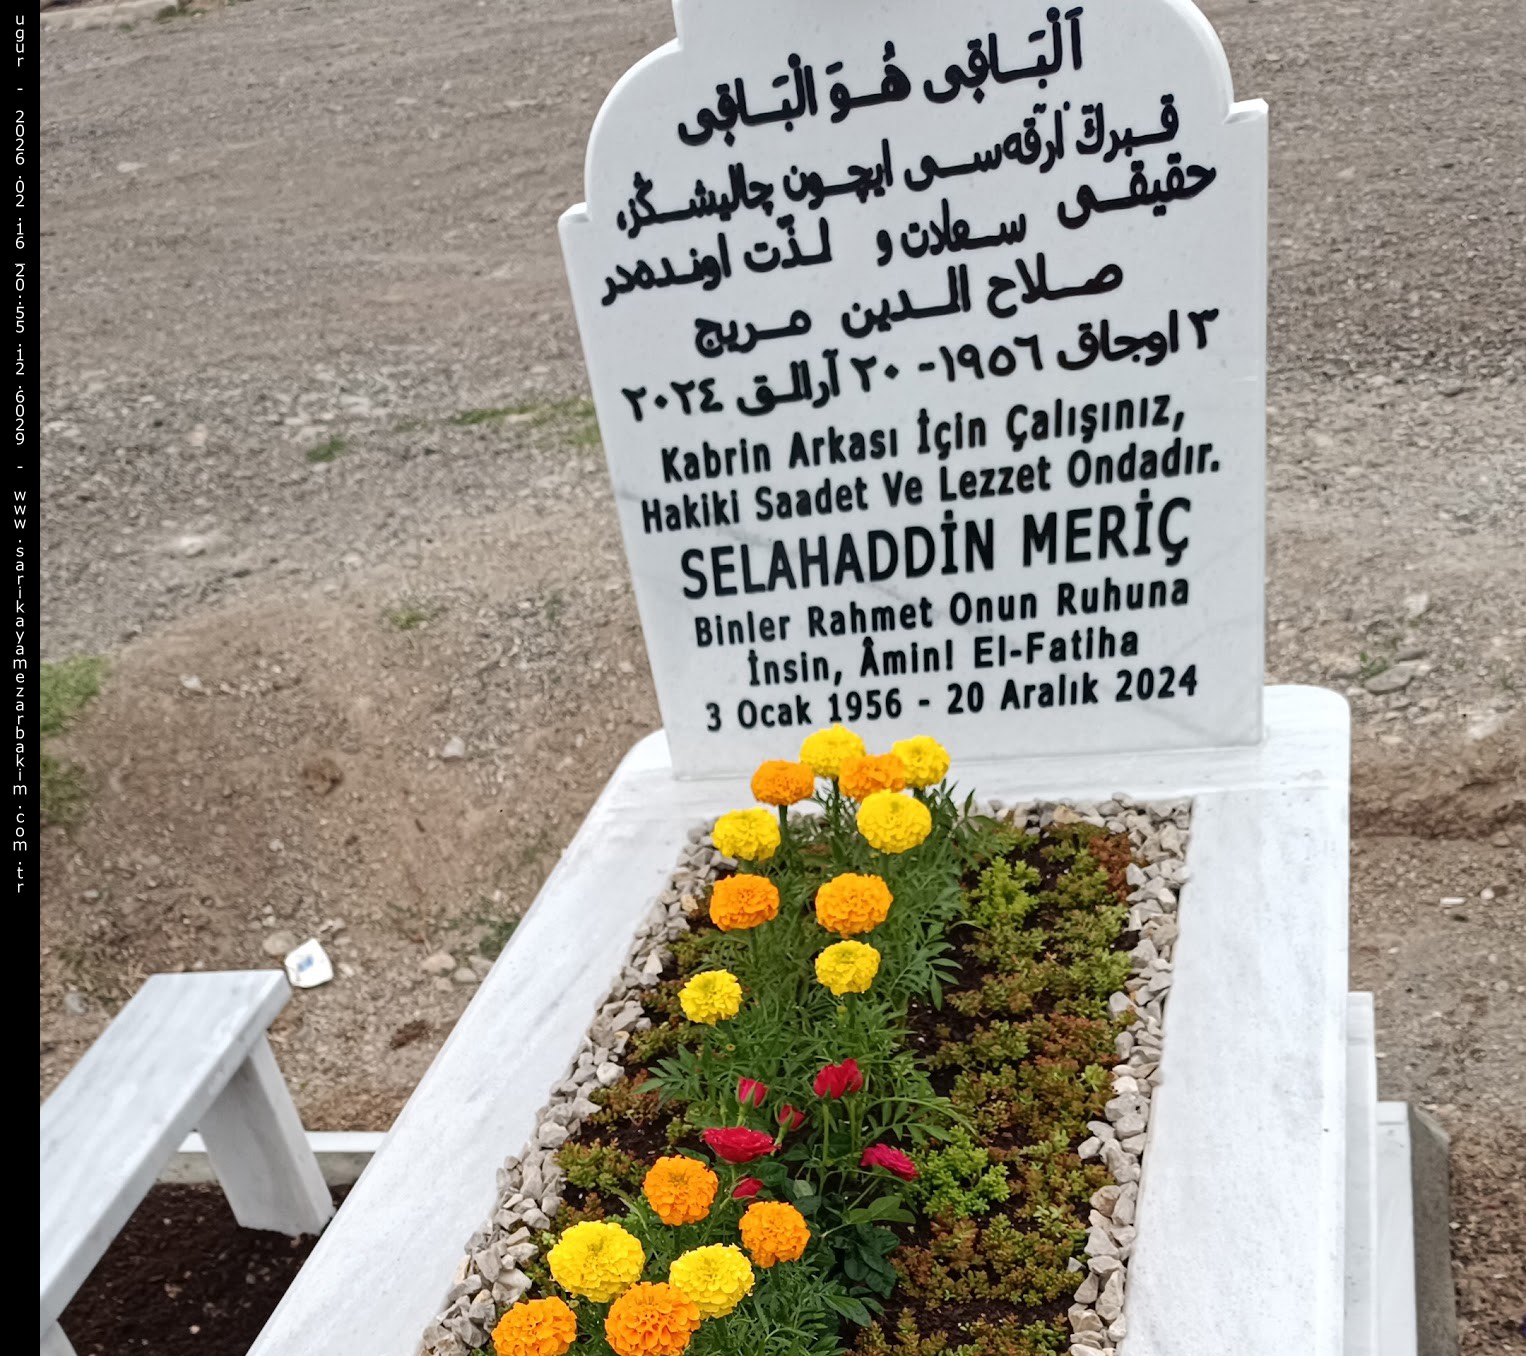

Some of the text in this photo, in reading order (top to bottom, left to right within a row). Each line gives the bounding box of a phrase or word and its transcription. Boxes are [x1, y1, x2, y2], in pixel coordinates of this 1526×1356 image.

[876, 229, 893, 267] و
[986, 252, 1124, 319] صلاح
[621, 377, 724, 422] ٢٠٢٤
[850, 355, 899, 393] ٢٠
[661, 394, 1185, 483] Kabrin Arkası İçin Çalışınız,
[641, 436, 1220, 534] Hakiki Saadet Ve Lezzet Ondadır.
[680, 488, 1192, 600] SELAHADDİN MERİÇ
[694, 576, 1189, 647] Binler Rahmet Onun Ruhuna
[747, 626, 1138, 687] İnsin, Âmin! El-Fatiha
[706, 664, 1198, 732] 3 Ocak 1956 - 20 Aralık 2024
